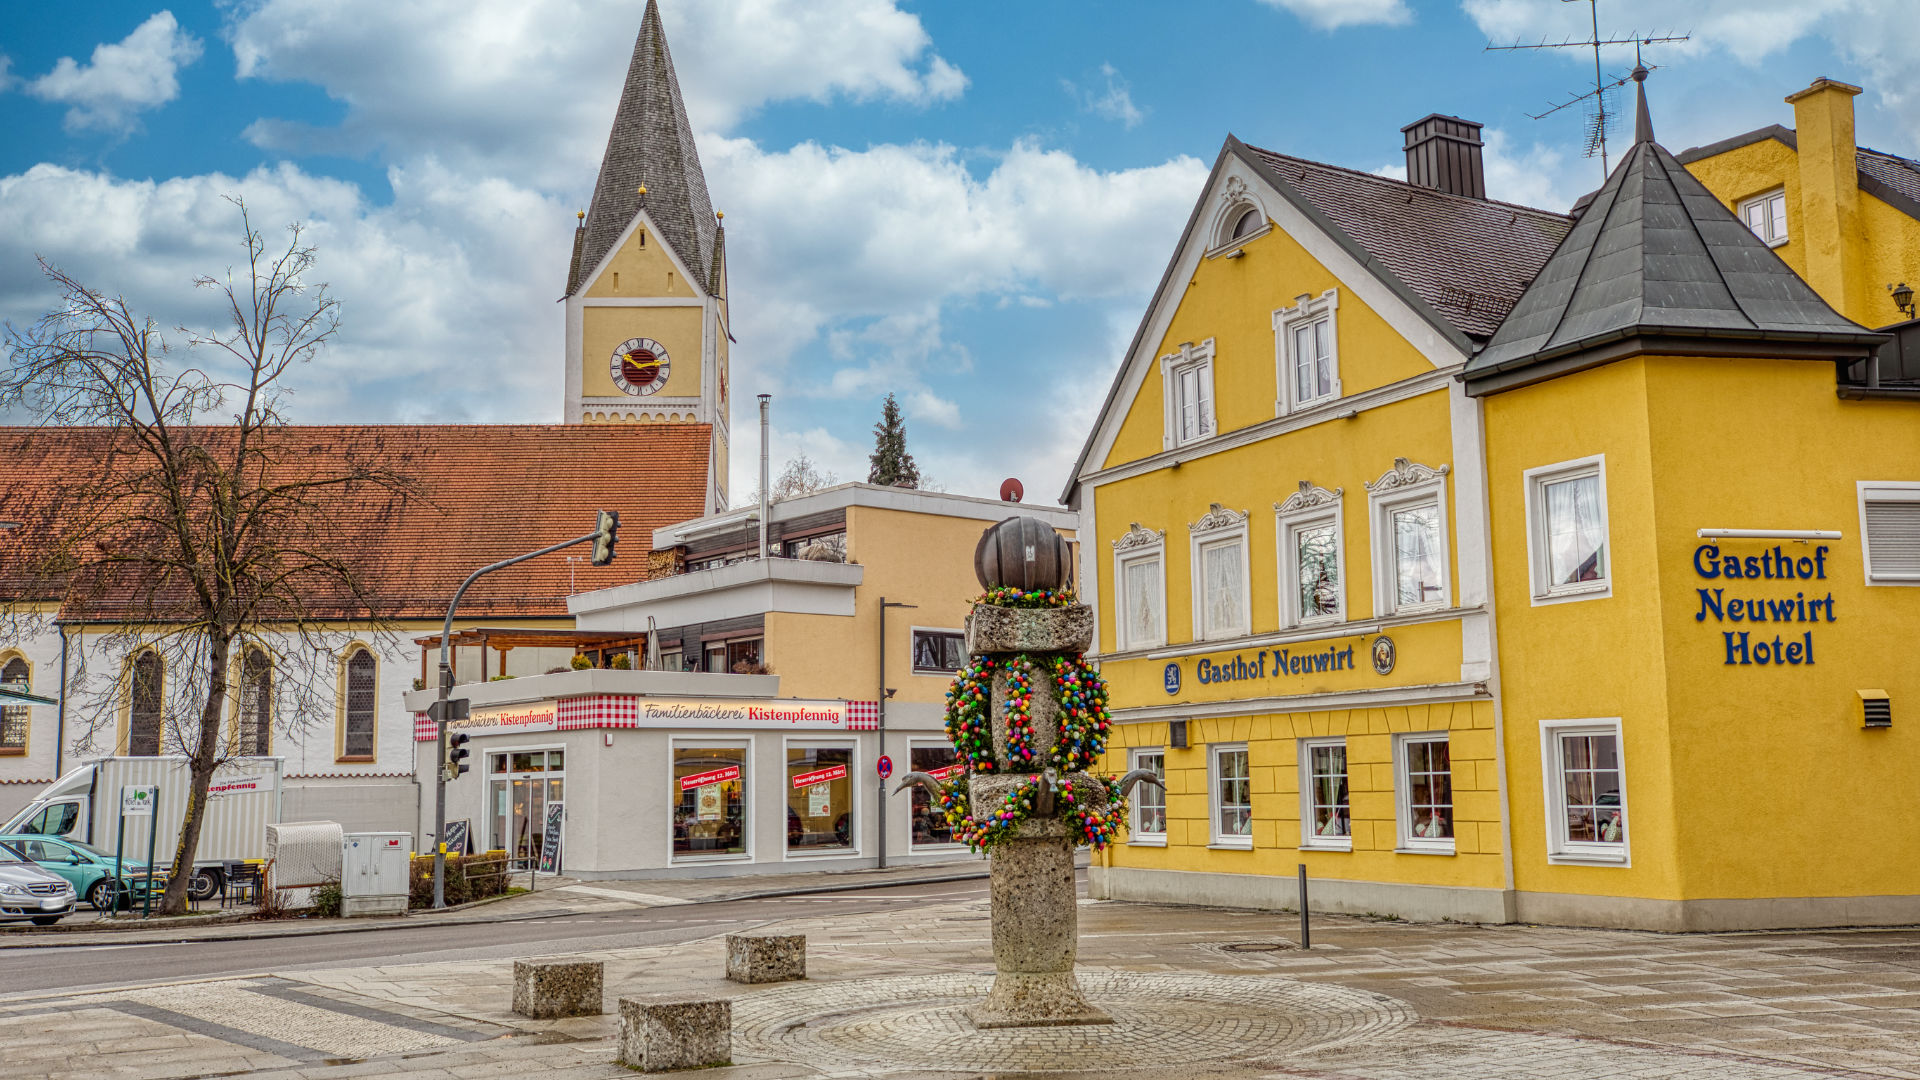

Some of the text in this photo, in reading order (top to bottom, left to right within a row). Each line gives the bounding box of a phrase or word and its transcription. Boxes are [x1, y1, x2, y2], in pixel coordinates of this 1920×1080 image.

[1694, 544, 1829, 579] Gasthof
[1695, 588, 1837, 622] Neuwirt
[1197, 644, 1354, 684] Gasthof Neuwirt
[1722, 631, 1815, 665] Hotel
[500, 709, 554, 728] Kistenpfennig
[645, 704, 840, 724] Familienbäckerei Kistenpfennig
[207, 782, 257, 793] tenpfennig
